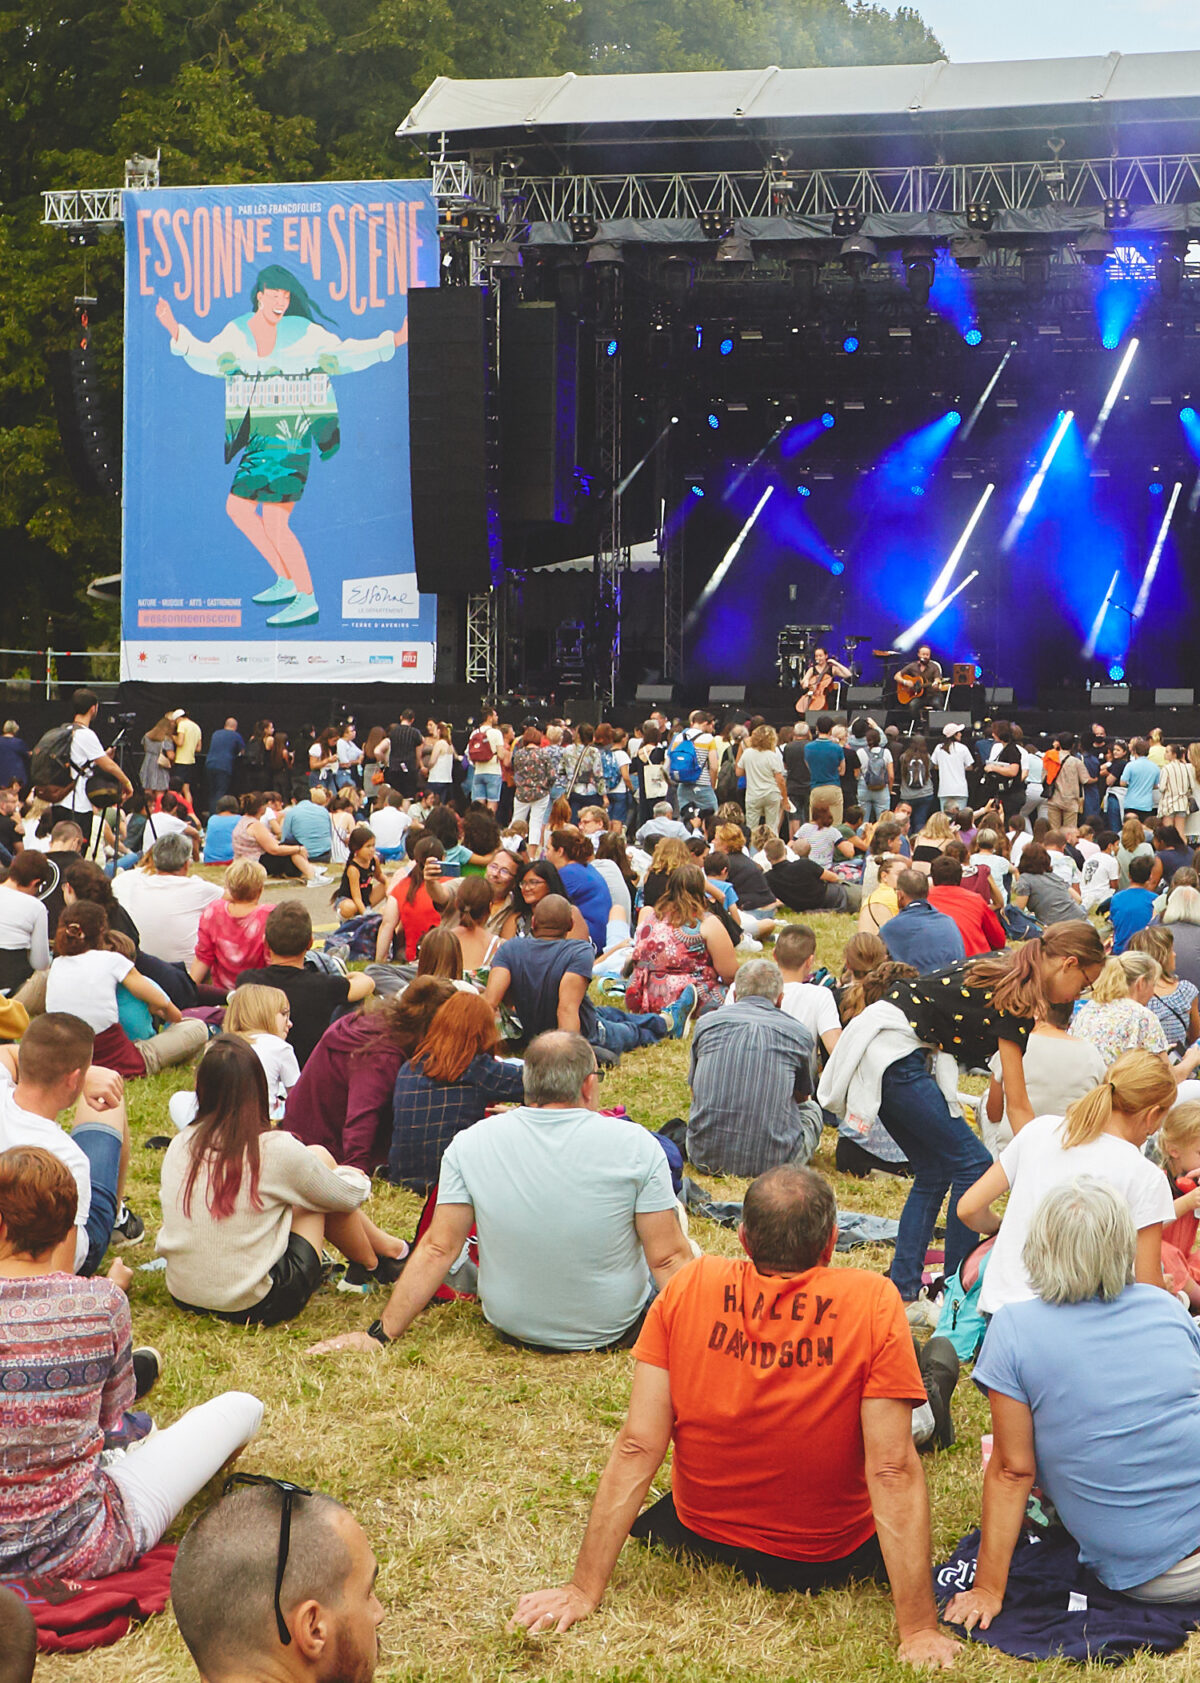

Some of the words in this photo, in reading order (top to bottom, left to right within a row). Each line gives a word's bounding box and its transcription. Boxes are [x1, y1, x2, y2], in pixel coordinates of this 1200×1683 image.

[238, 204, 252, 215] PAR
[254, 204, 268, 215] LES
[269, 202, 322, 214] FRANCOFOLIES
[136, 206, 272, 318] ESSONNE
[283, 216, 321, 280] EN
[708, 1321, 833, 1369] DAVIDSON
